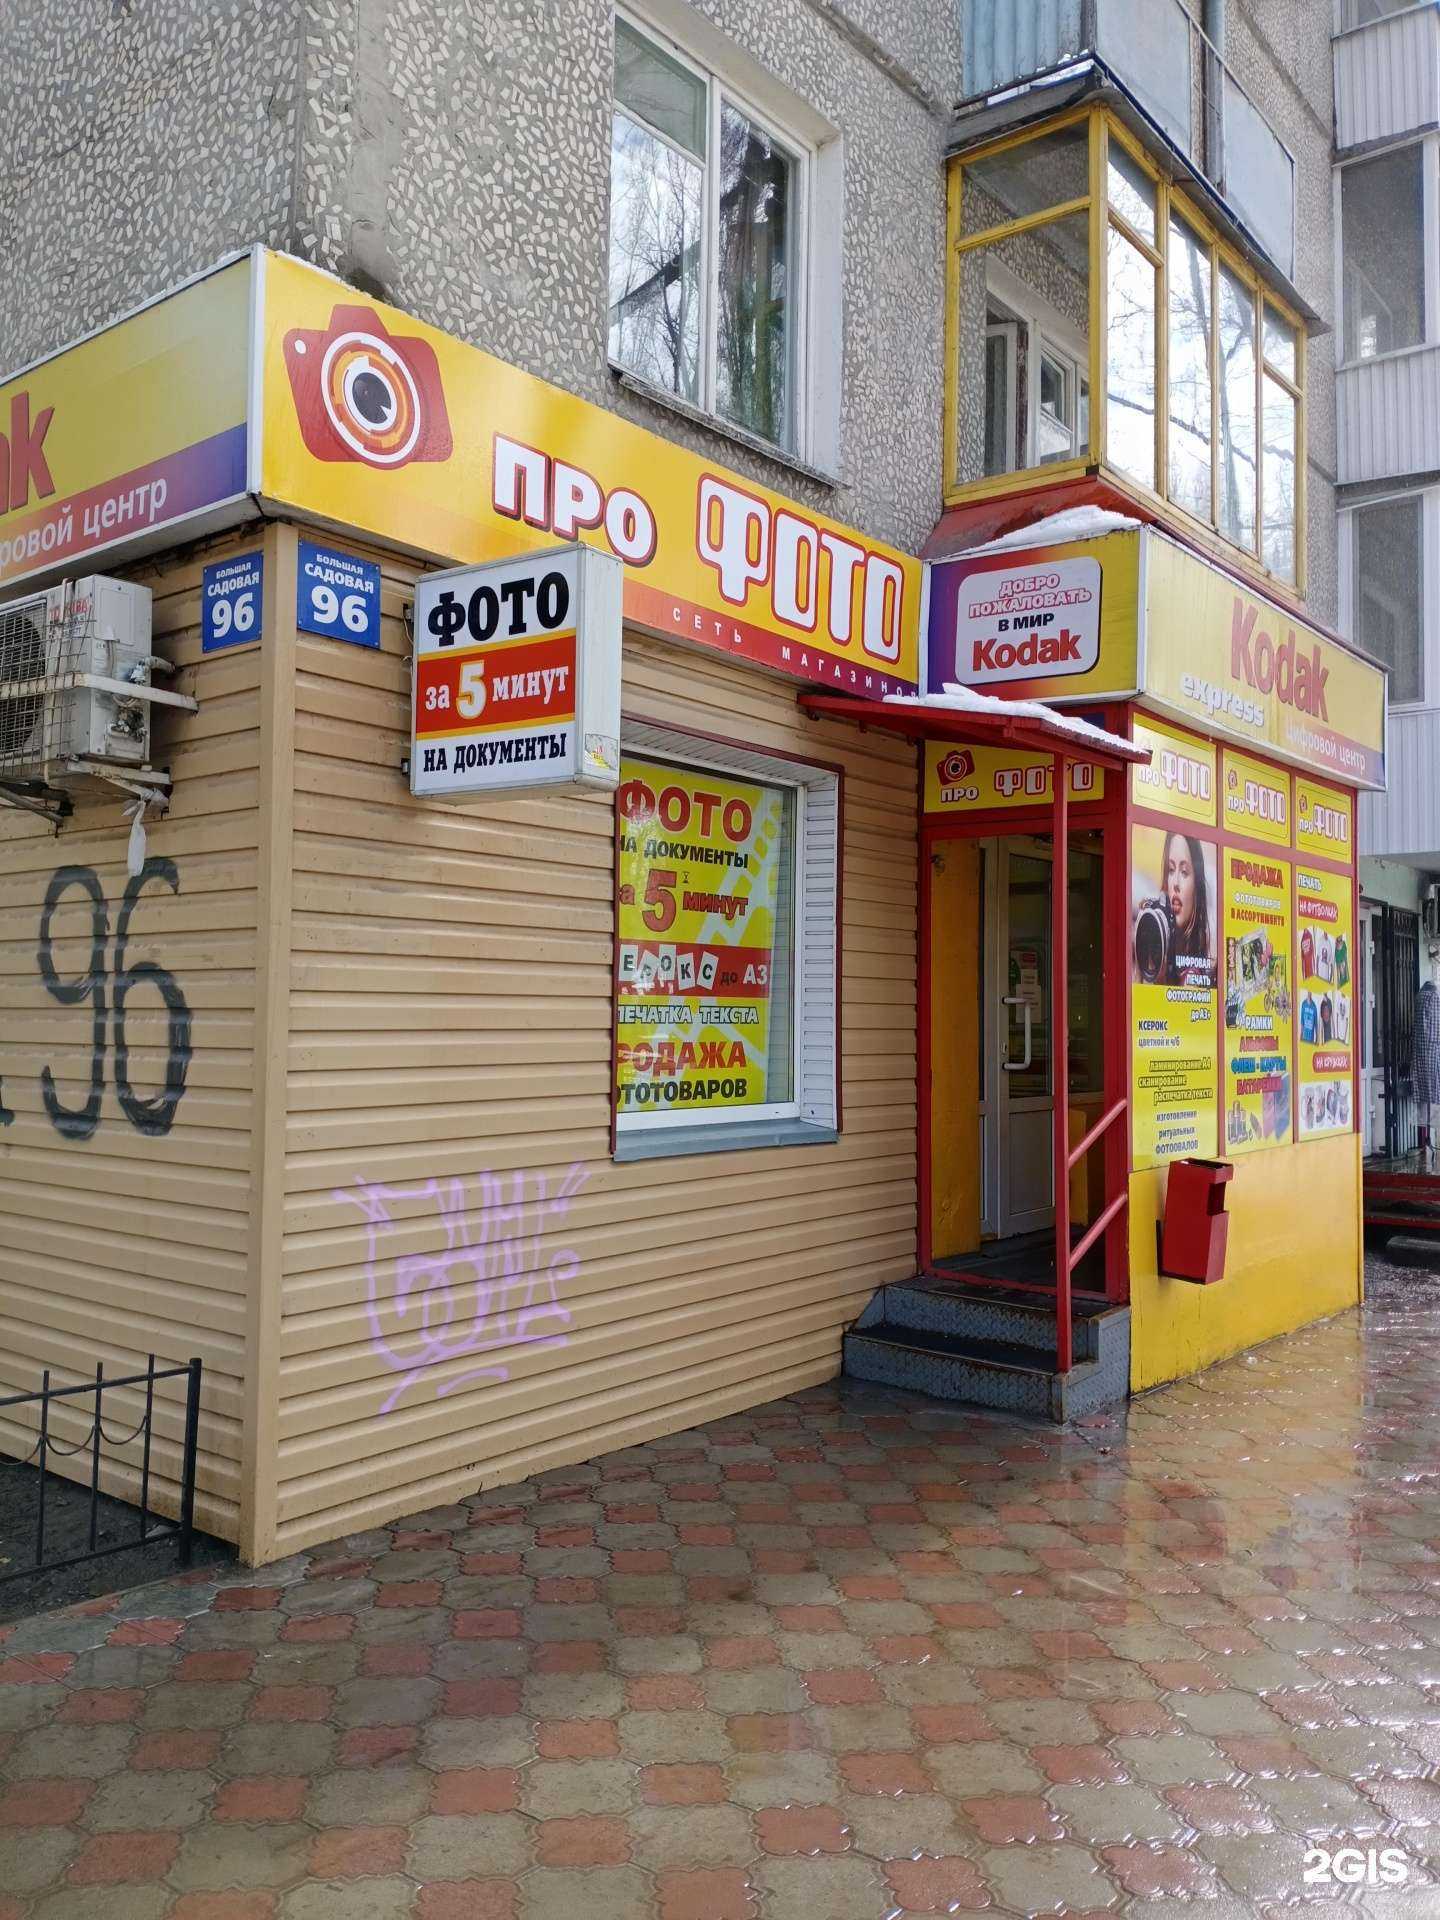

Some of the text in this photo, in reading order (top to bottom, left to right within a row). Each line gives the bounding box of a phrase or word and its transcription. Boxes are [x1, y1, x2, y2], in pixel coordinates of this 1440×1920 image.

[83, 478, 167, 538] центр
[316, 553, 364, 575] БОЛЬШАЯ
[492, 432, 905, 665] ПРО ФОТО
[207, 571, 260, 597] САДОВАЯ
[216, 562, 251, 579] БОЛЬШАЯ
[304, 563, 374, 594] САДОВАЯ
[999, 574, 1061, 599] ДОБРО
[212, 592, 255, 638] 96
[311, 585, 369, 633] 96
[427, 571, 570, 647] ФОТО
[968, 588, 1092, 619] ПОЖАЛОВАТЬ
[998, 613, 1055, 632] В МИР
[672, 606, 742, 645] СЕТЬ
[972, 628, 1082, 672] Kodak
[1231, 595, 1330, 722] Kodak
[425, 659, 569, 720] за 5 минут
[1182, 674, 1265, 728] express
[423, 748, 448, 773] НА
[453, 733, 567, 774] ДОКУМЕНТЫ
[1339, 743, 1366, 776] центр
[941, 762, 1094, 803] ПРО ФОО
[1138, 751, 1211, 800] ПРО ФОТО
[619, 779, 752, 843] ФОТО
[1228, 780, 1286, 824] ПРО ФОТО
[1299, 803, 1348, 842] ПРО ФОТО
[644, 839, 749, 869] ДОКУМЕНТЫ
[1231, 858, 1284, 889] ПРОДАЖА
[642, 868, 678, 933] 5
[720, 971, 738, 986] до
[742, 963, 768, 985] А3
[1175, 955, 1211, 969] ЦИФРОВАЯ
[1186, 974, 1211, 986] ПЕЧАТЬ
[38, 857, 192, 1140] 96
[699, 1005, 759, 1025] ТЕКСТА
[1138, 1020, 1168, 1031] КСЕРОКС
[1245, 1015, 1273, 1031] РАМКИ
[1138, 1074, 1187, 1091] сканирование
